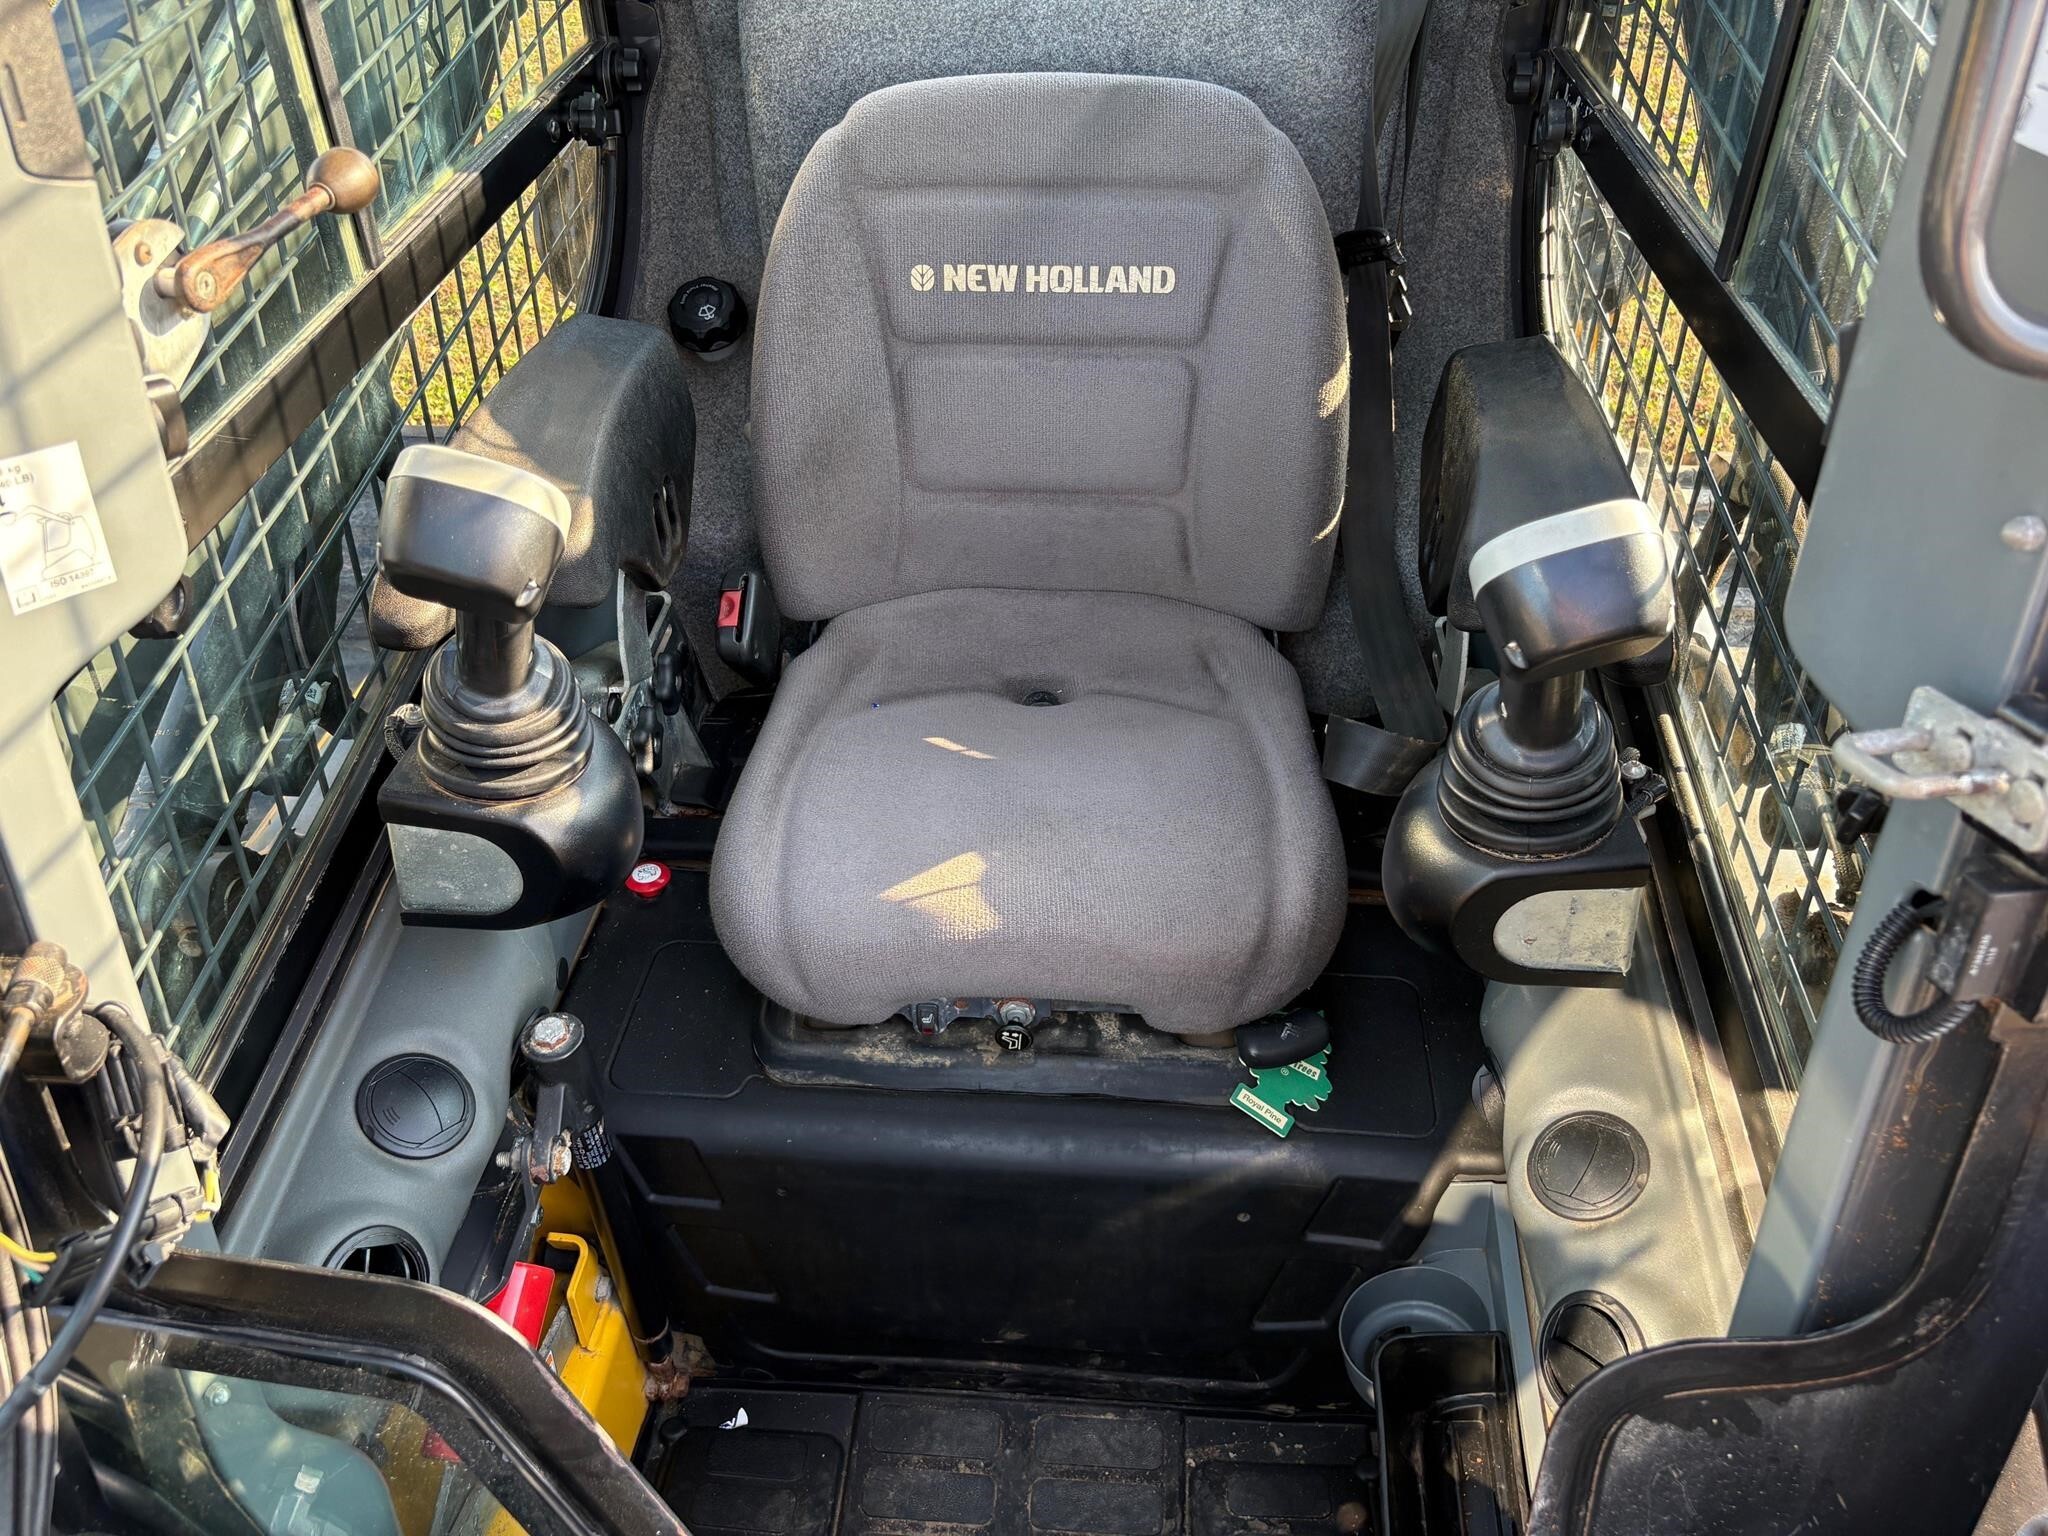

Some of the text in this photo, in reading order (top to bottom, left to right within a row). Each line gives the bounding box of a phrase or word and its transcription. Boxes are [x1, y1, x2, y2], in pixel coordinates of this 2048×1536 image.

[943, 263, 1176, 294] NEW HOLLAND
[50, 576, 68, 588] ISO
[1242, 1093, 1282, 1124] Royal Pine
